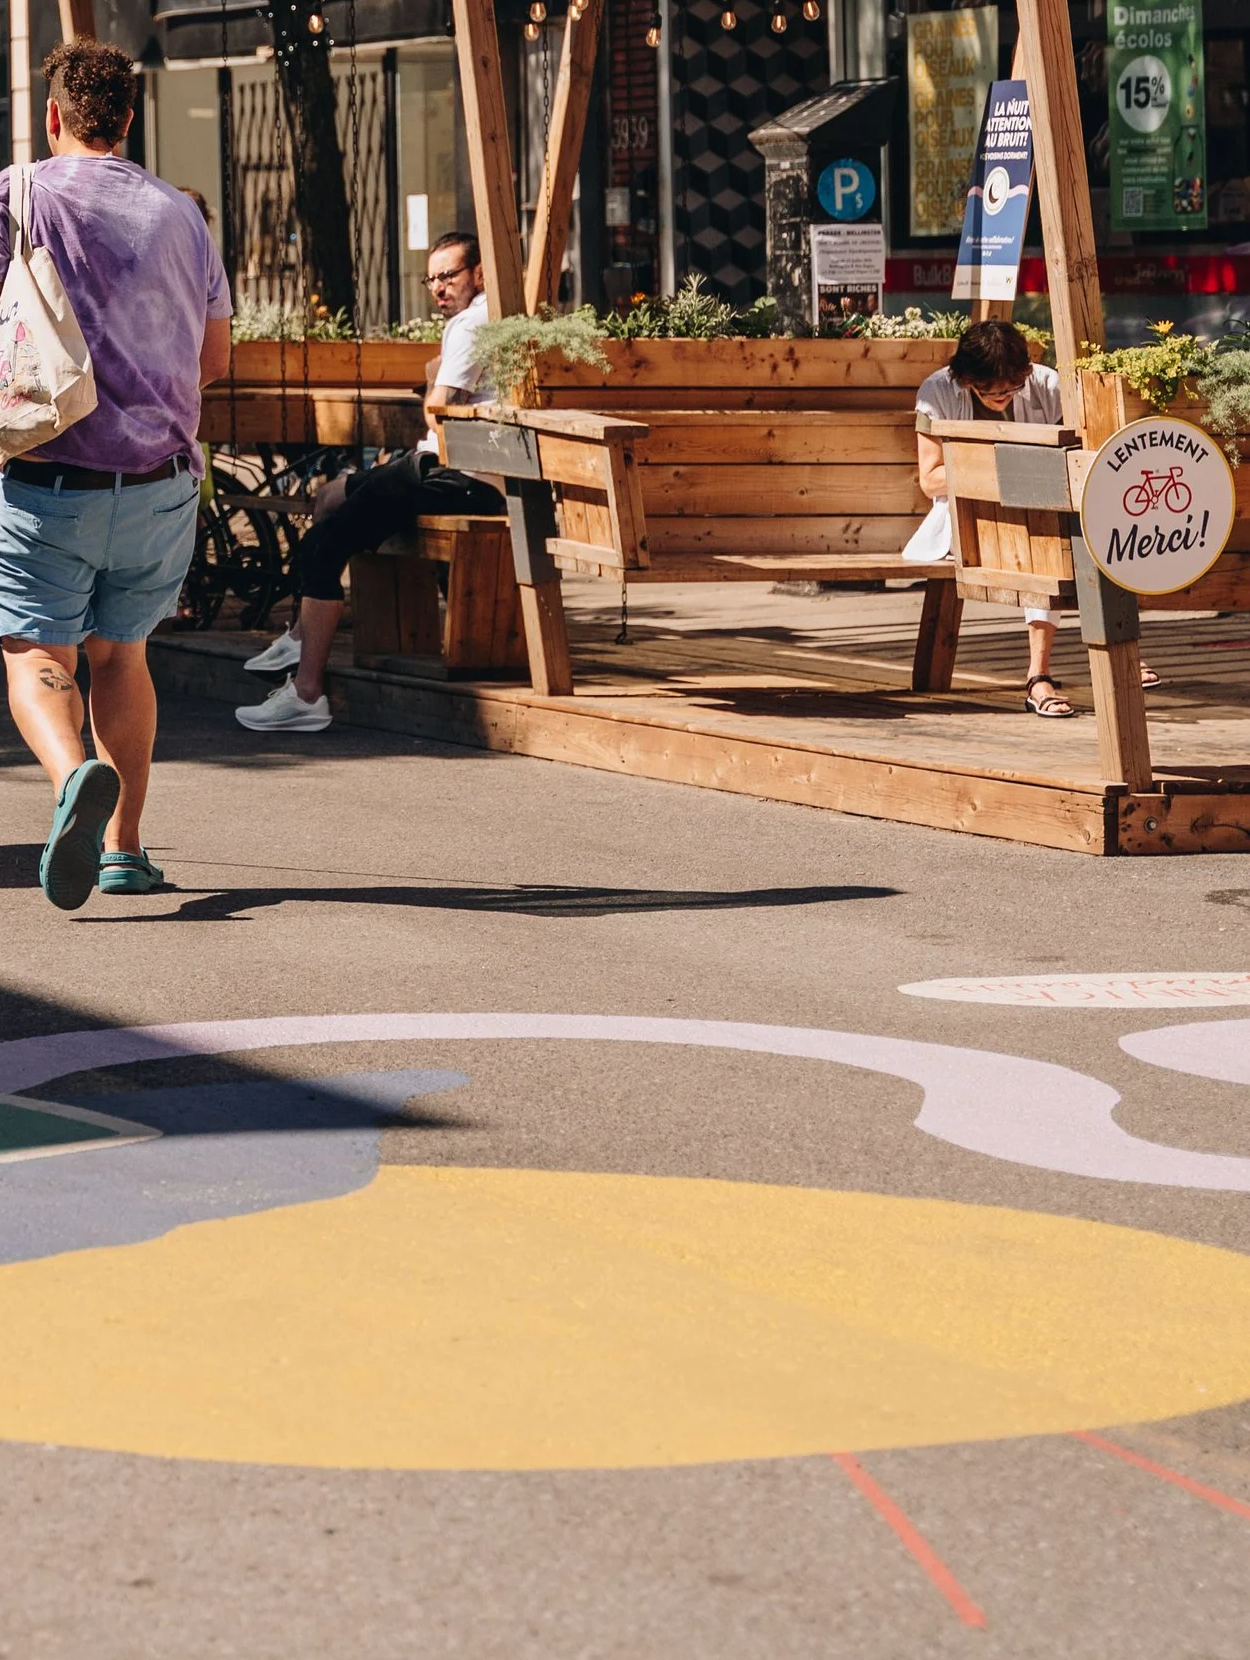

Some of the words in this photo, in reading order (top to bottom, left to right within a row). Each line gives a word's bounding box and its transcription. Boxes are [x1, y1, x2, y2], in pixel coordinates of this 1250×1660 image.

[1114, 4, 1195, 26] Dimanches
[913, 17, 975, 40] GRAINES
[1114, 29, 1172, 49] écolos
[914, 41, 954, 59] POUR
[913, 58, 975, 79] OISEAUX
[914, 88, 975, 109] GRAINES
[994, 101, 1005, 116] LA
[1006, 100, 1029, 116] NUIT
[914, 110, 954, 129] POUR
[985, 116, 1032, 132] ATTENTION
[612, 116, 648, 149] 3939
[914, 128, 975, 148] OISEAUX
[985, 132, 998, 147] AU
[998, 131, 1029, 147] BRUIT!
[834, 168, 859, 211] P
[819, 285, 844, 293] SONT
[847, 284, 877, 293] RICHES
[1107, 430, 1209, 472] LENTEMENT
